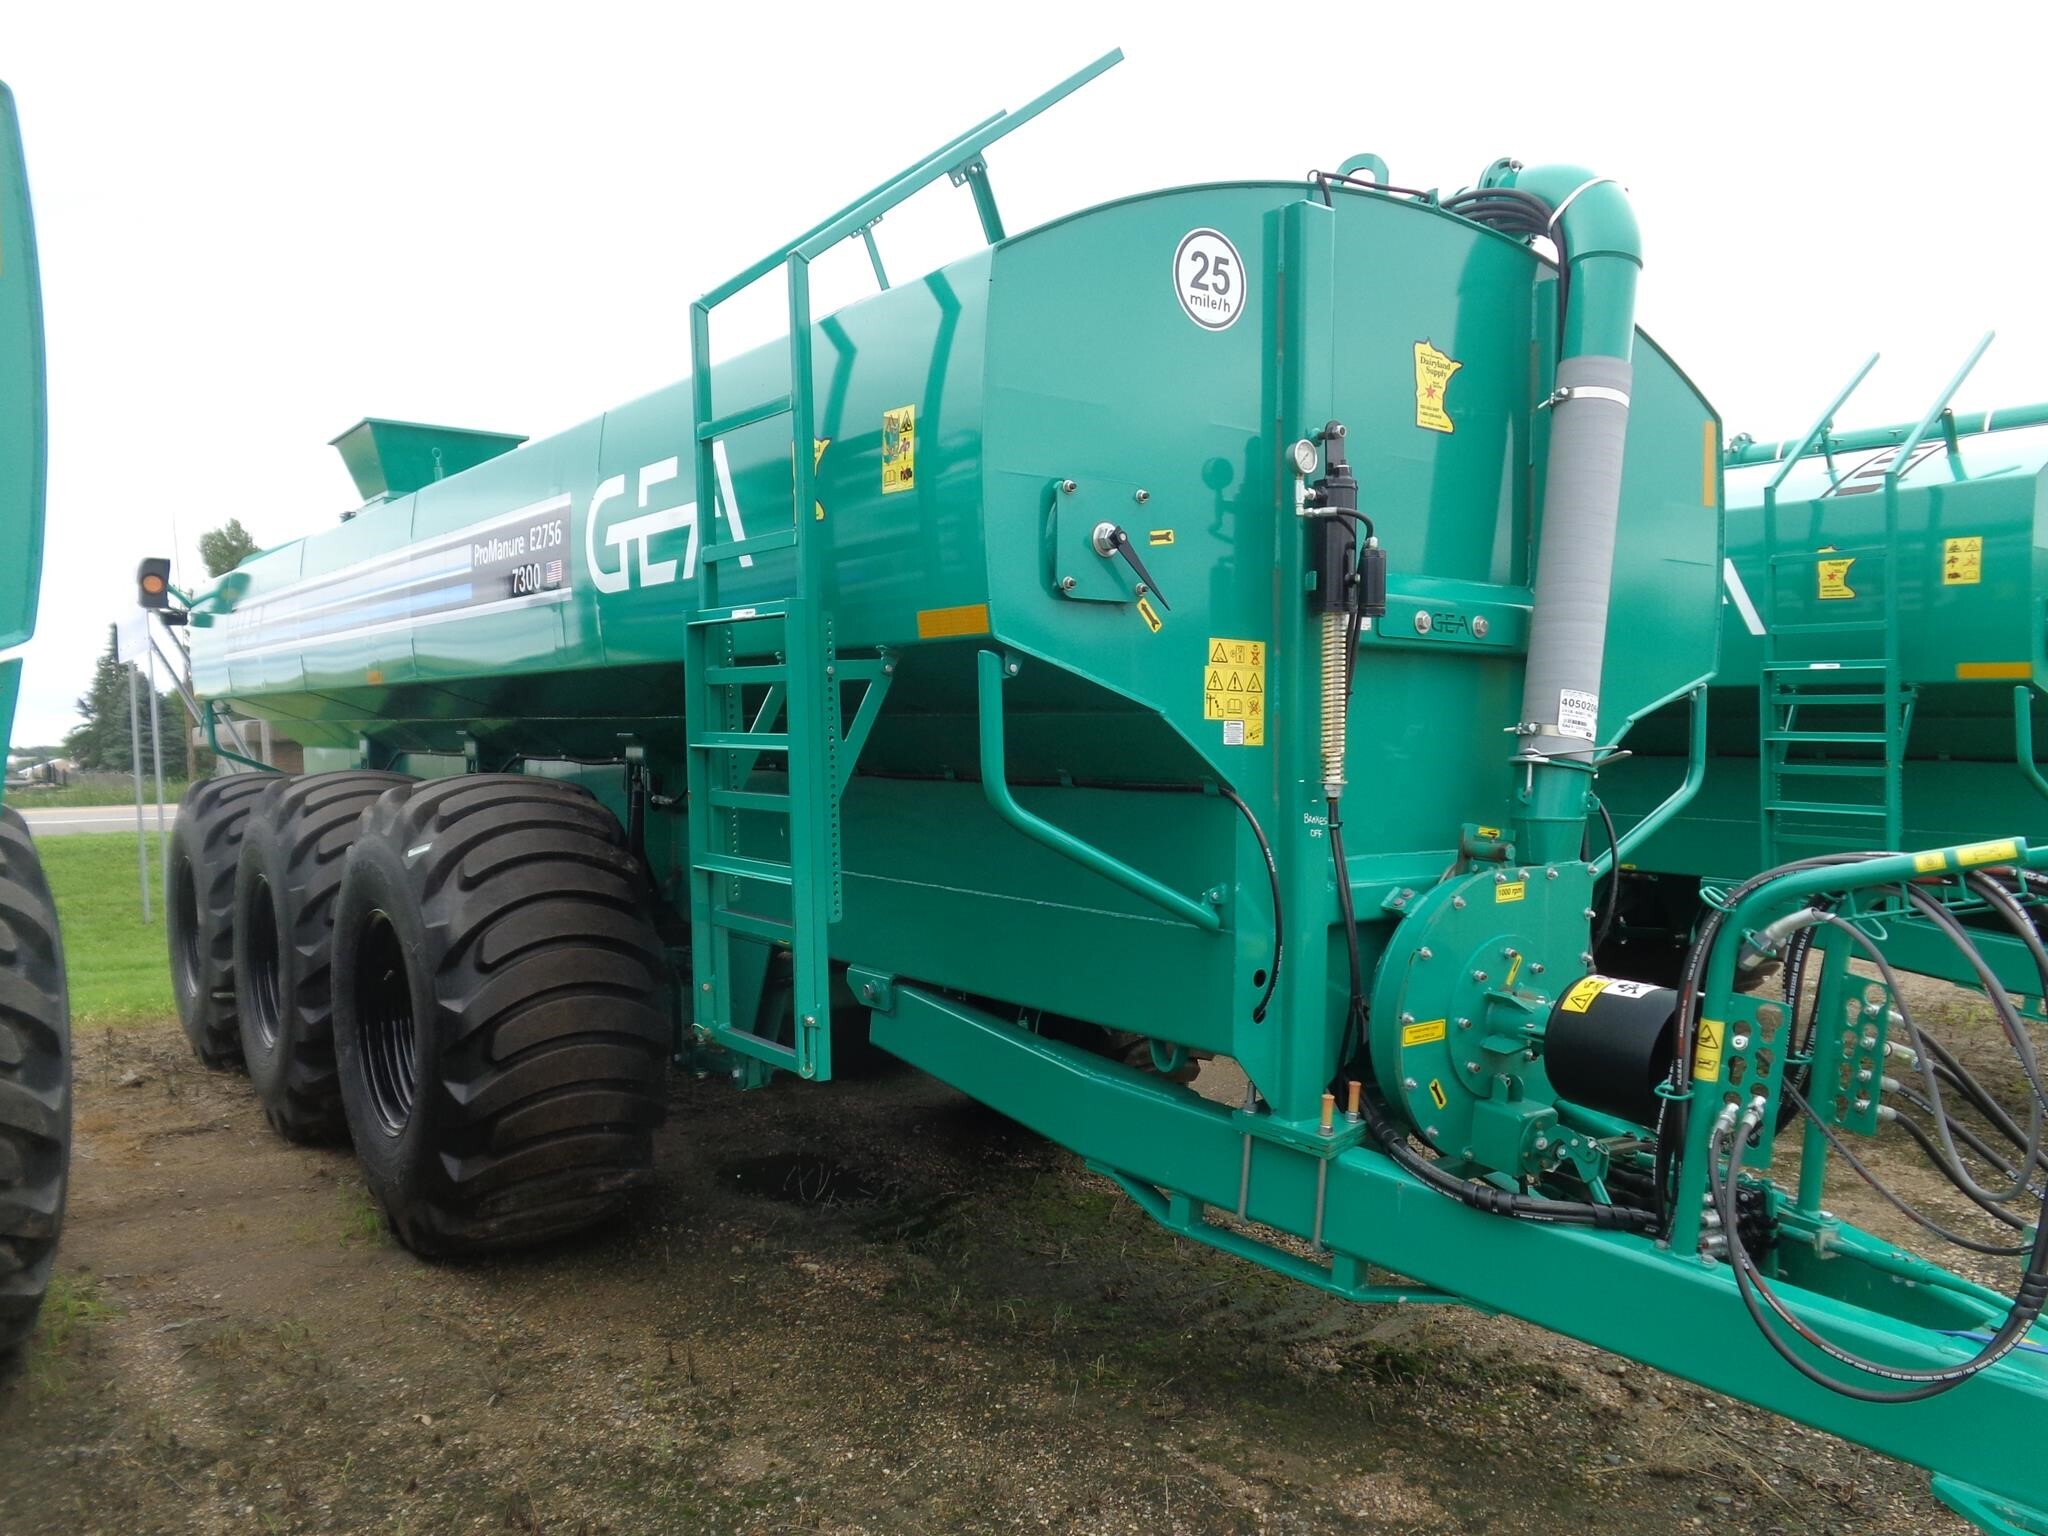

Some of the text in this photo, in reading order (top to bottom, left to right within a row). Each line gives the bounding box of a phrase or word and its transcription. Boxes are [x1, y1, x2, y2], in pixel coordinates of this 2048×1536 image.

[1190, 250, 1230, 295] 25
[1190, 294, 1230, 313] mile/h
[1420, 356, 1451, 371] Dairyland
[1426, 366, 1447, 378] Supply
[585, 440, 753, 594] GEA
[474, 520, 561, 567] ProManure E2756
[512, 563, 541, 593] 7300
[1432, 612, 1470, 635] GEA
[1310, 829, 1323, 838] OFF
